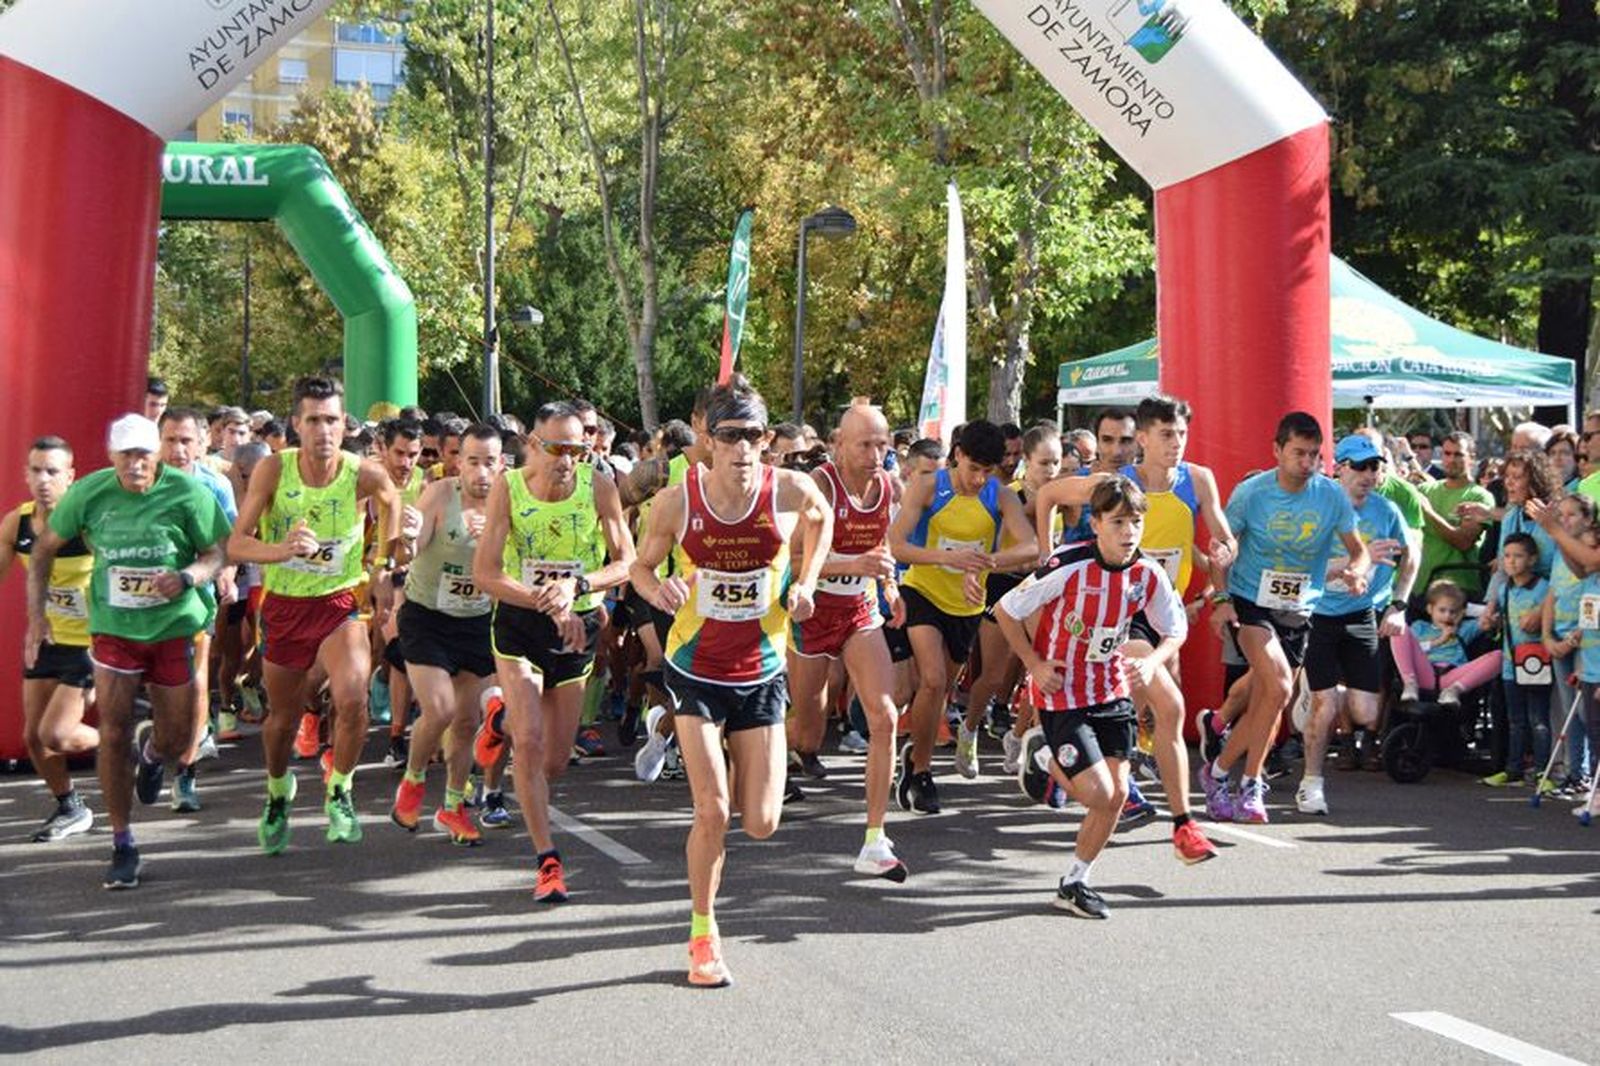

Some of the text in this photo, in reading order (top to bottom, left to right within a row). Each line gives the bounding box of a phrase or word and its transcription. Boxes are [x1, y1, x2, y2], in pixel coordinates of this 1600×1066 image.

[197, 53, 235, 91] DE
[1027, 4, 1152, 138] DE ZAMORA
[161, 154, 269, 187] URAL
[715, 550, 749, 560] VINO
[711, 582, 759, 602] 454
[1270, 580, 1302, 596] 554
